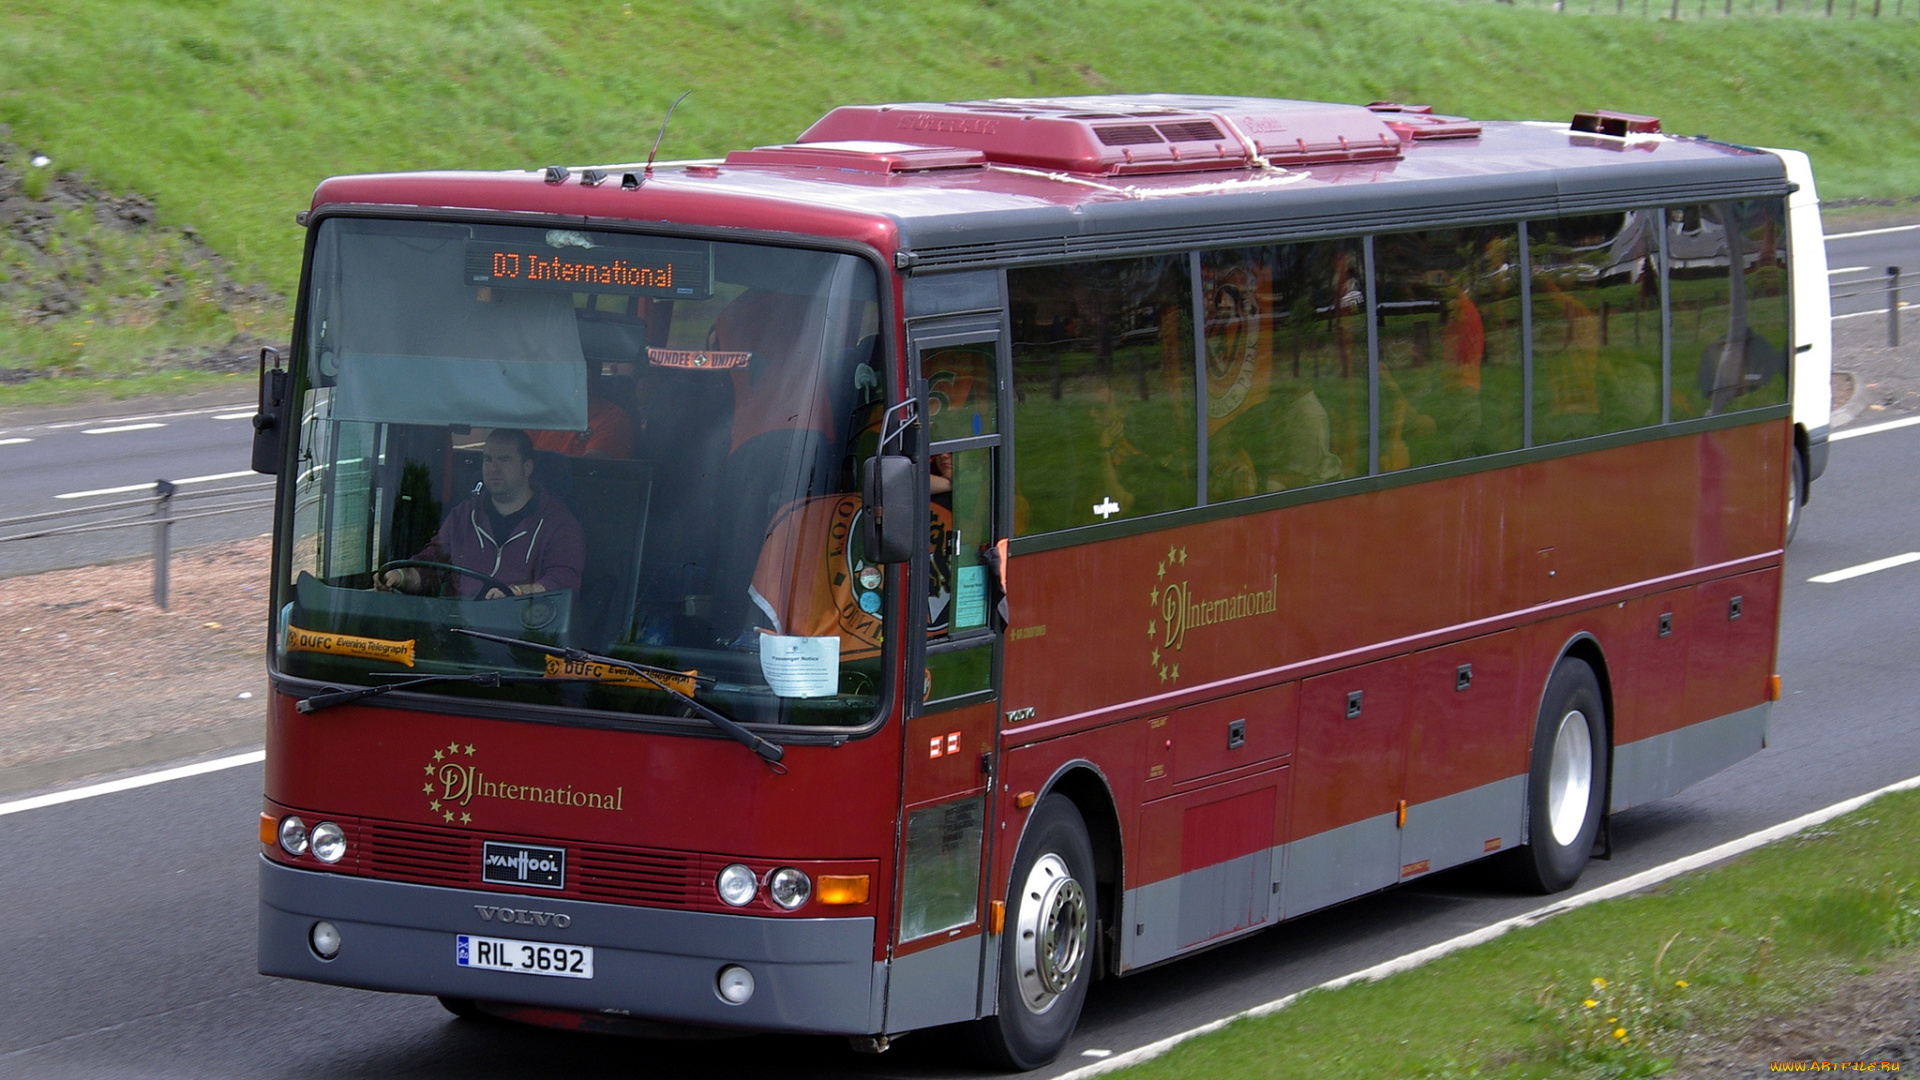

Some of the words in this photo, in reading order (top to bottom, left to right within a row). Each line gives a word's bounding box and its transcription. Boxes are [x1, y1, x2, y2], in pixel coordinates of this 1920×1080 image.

[493, 252, 520, 278] DJ
[527, 253, 673, 288] International
[649, 350, 691, 367] DUNDEE
[711, 353, 748, 367] UNITED
[1162, 580, 1188, 651] DJ
[1186, 573, 1278, 630] International
[300, 634, 332, 650] DUFC
[336, 637, 367, 652] Evening
[368, 641, 408, 655] Telegraph
[564, 663, 603, 677] DUFC
[438, 762, 476, 807] DJ
[476, 772, 624, 811] International
[474, 905, 571, 929] VOLVO
[477, 941, 513, 967] RIL
[521, 946, 584, 973] 3692
